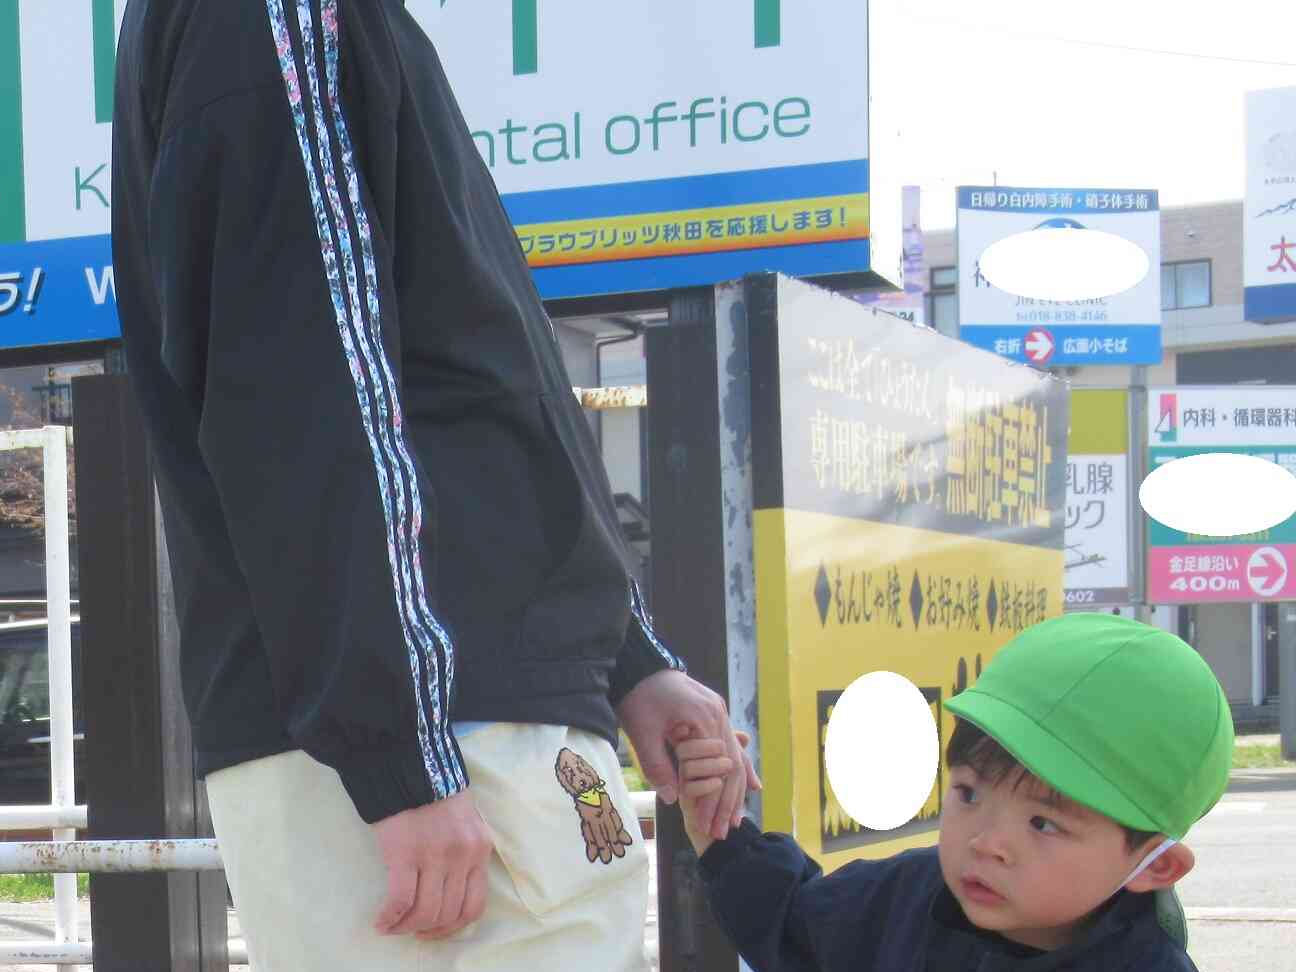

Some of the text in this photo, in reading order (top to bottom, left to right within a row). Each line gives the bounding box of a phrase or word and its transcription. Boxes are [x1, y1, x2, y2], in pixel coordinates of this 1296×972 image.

[605, 96, 811, 156] office
[1184, 407, 1296, 428] 内科・循環器科
